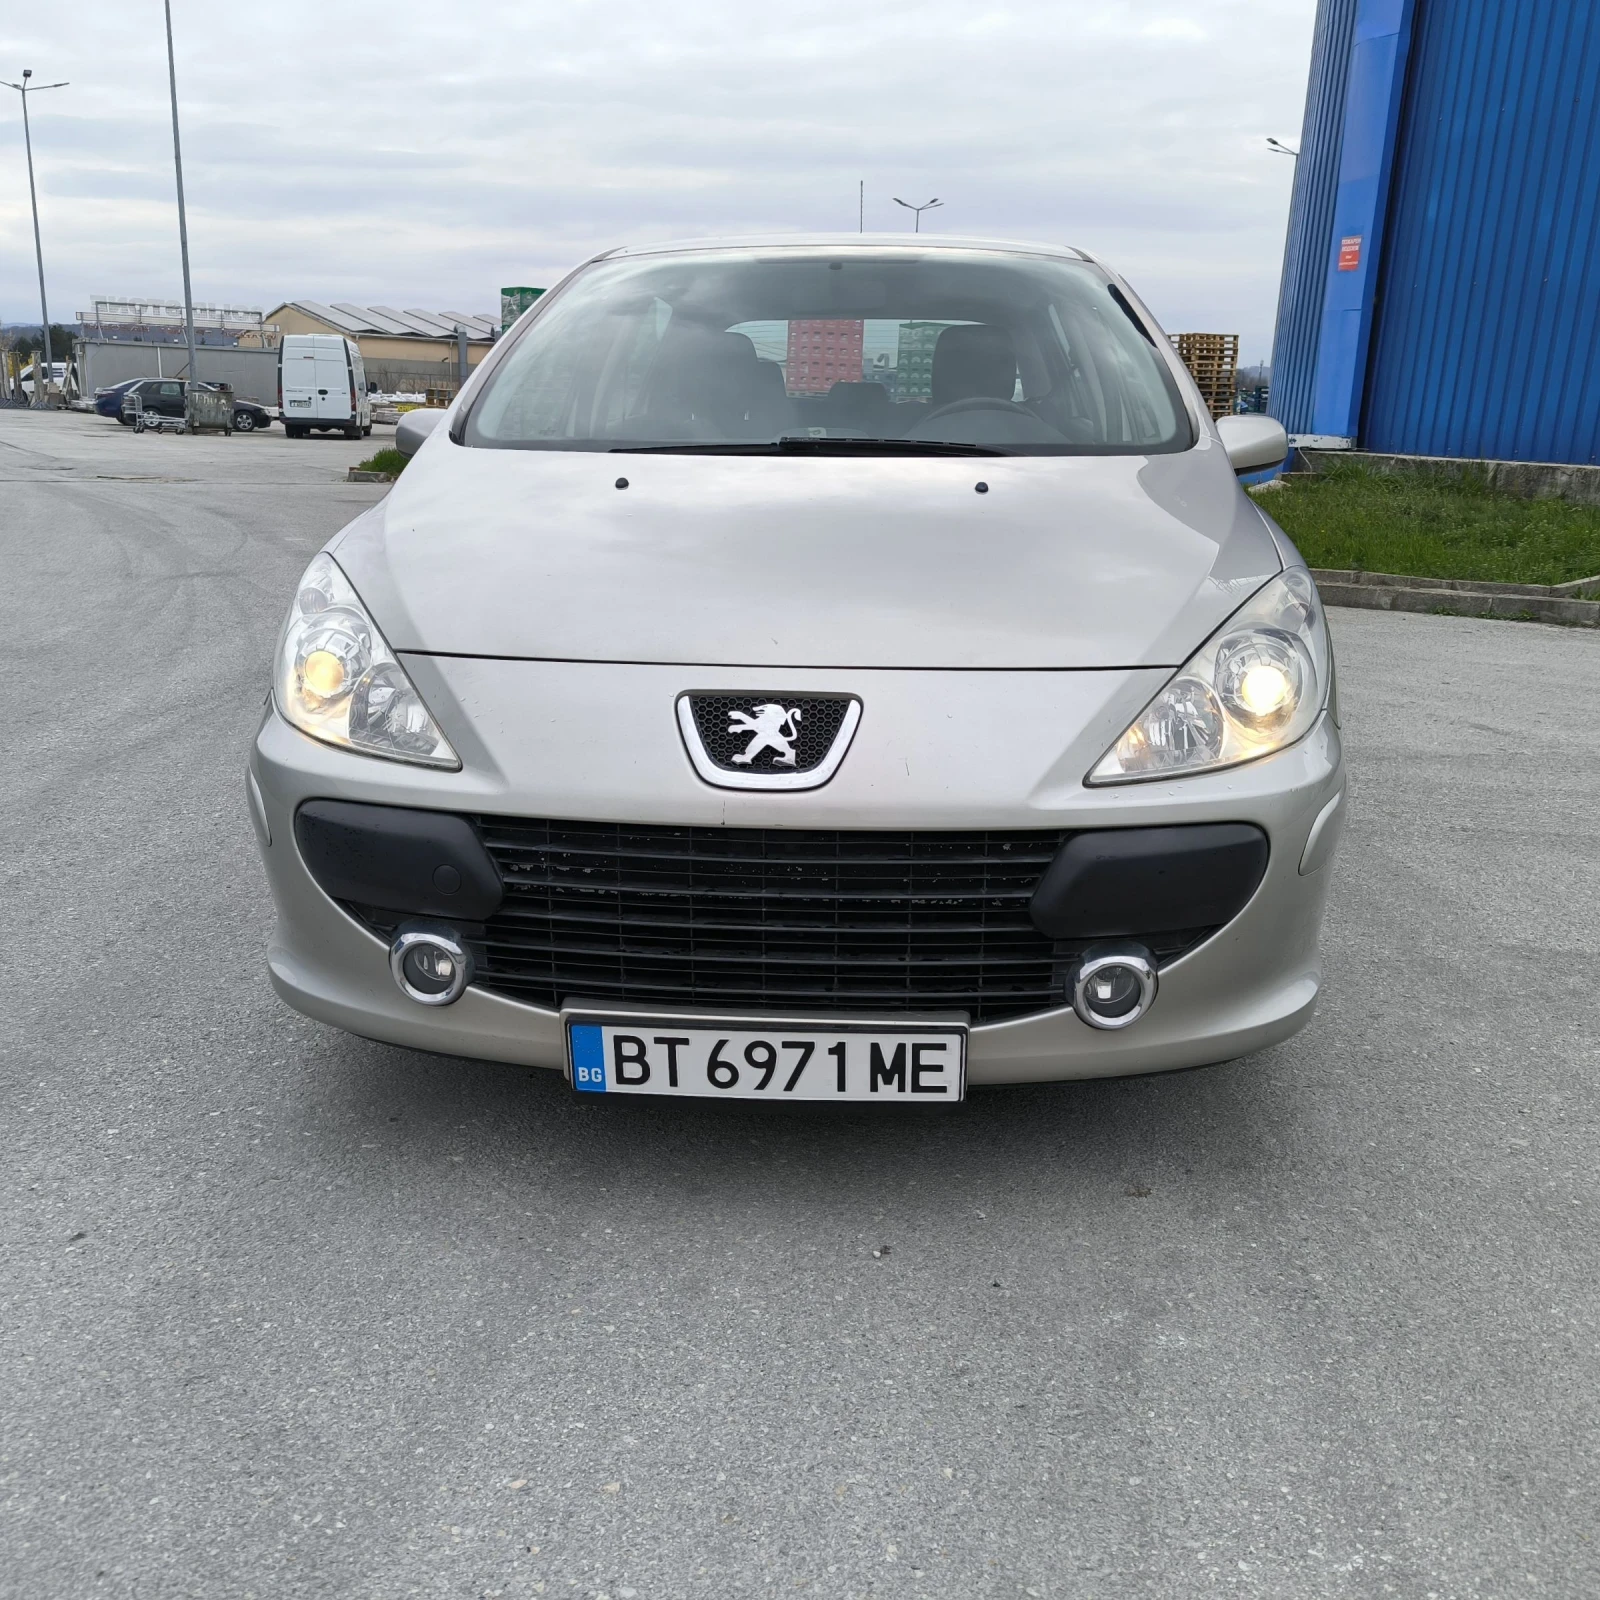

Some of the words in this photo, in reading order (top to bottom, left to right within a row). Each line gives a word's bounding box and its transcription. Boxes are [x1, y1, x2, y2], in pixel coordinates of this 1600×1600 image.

[578, 1066, 603, 1083] BG
[613, 1034, 690, 1087] BT
[706, 1038, 846, 1092] 6971
[869, 1042, 948, 1093] ME
